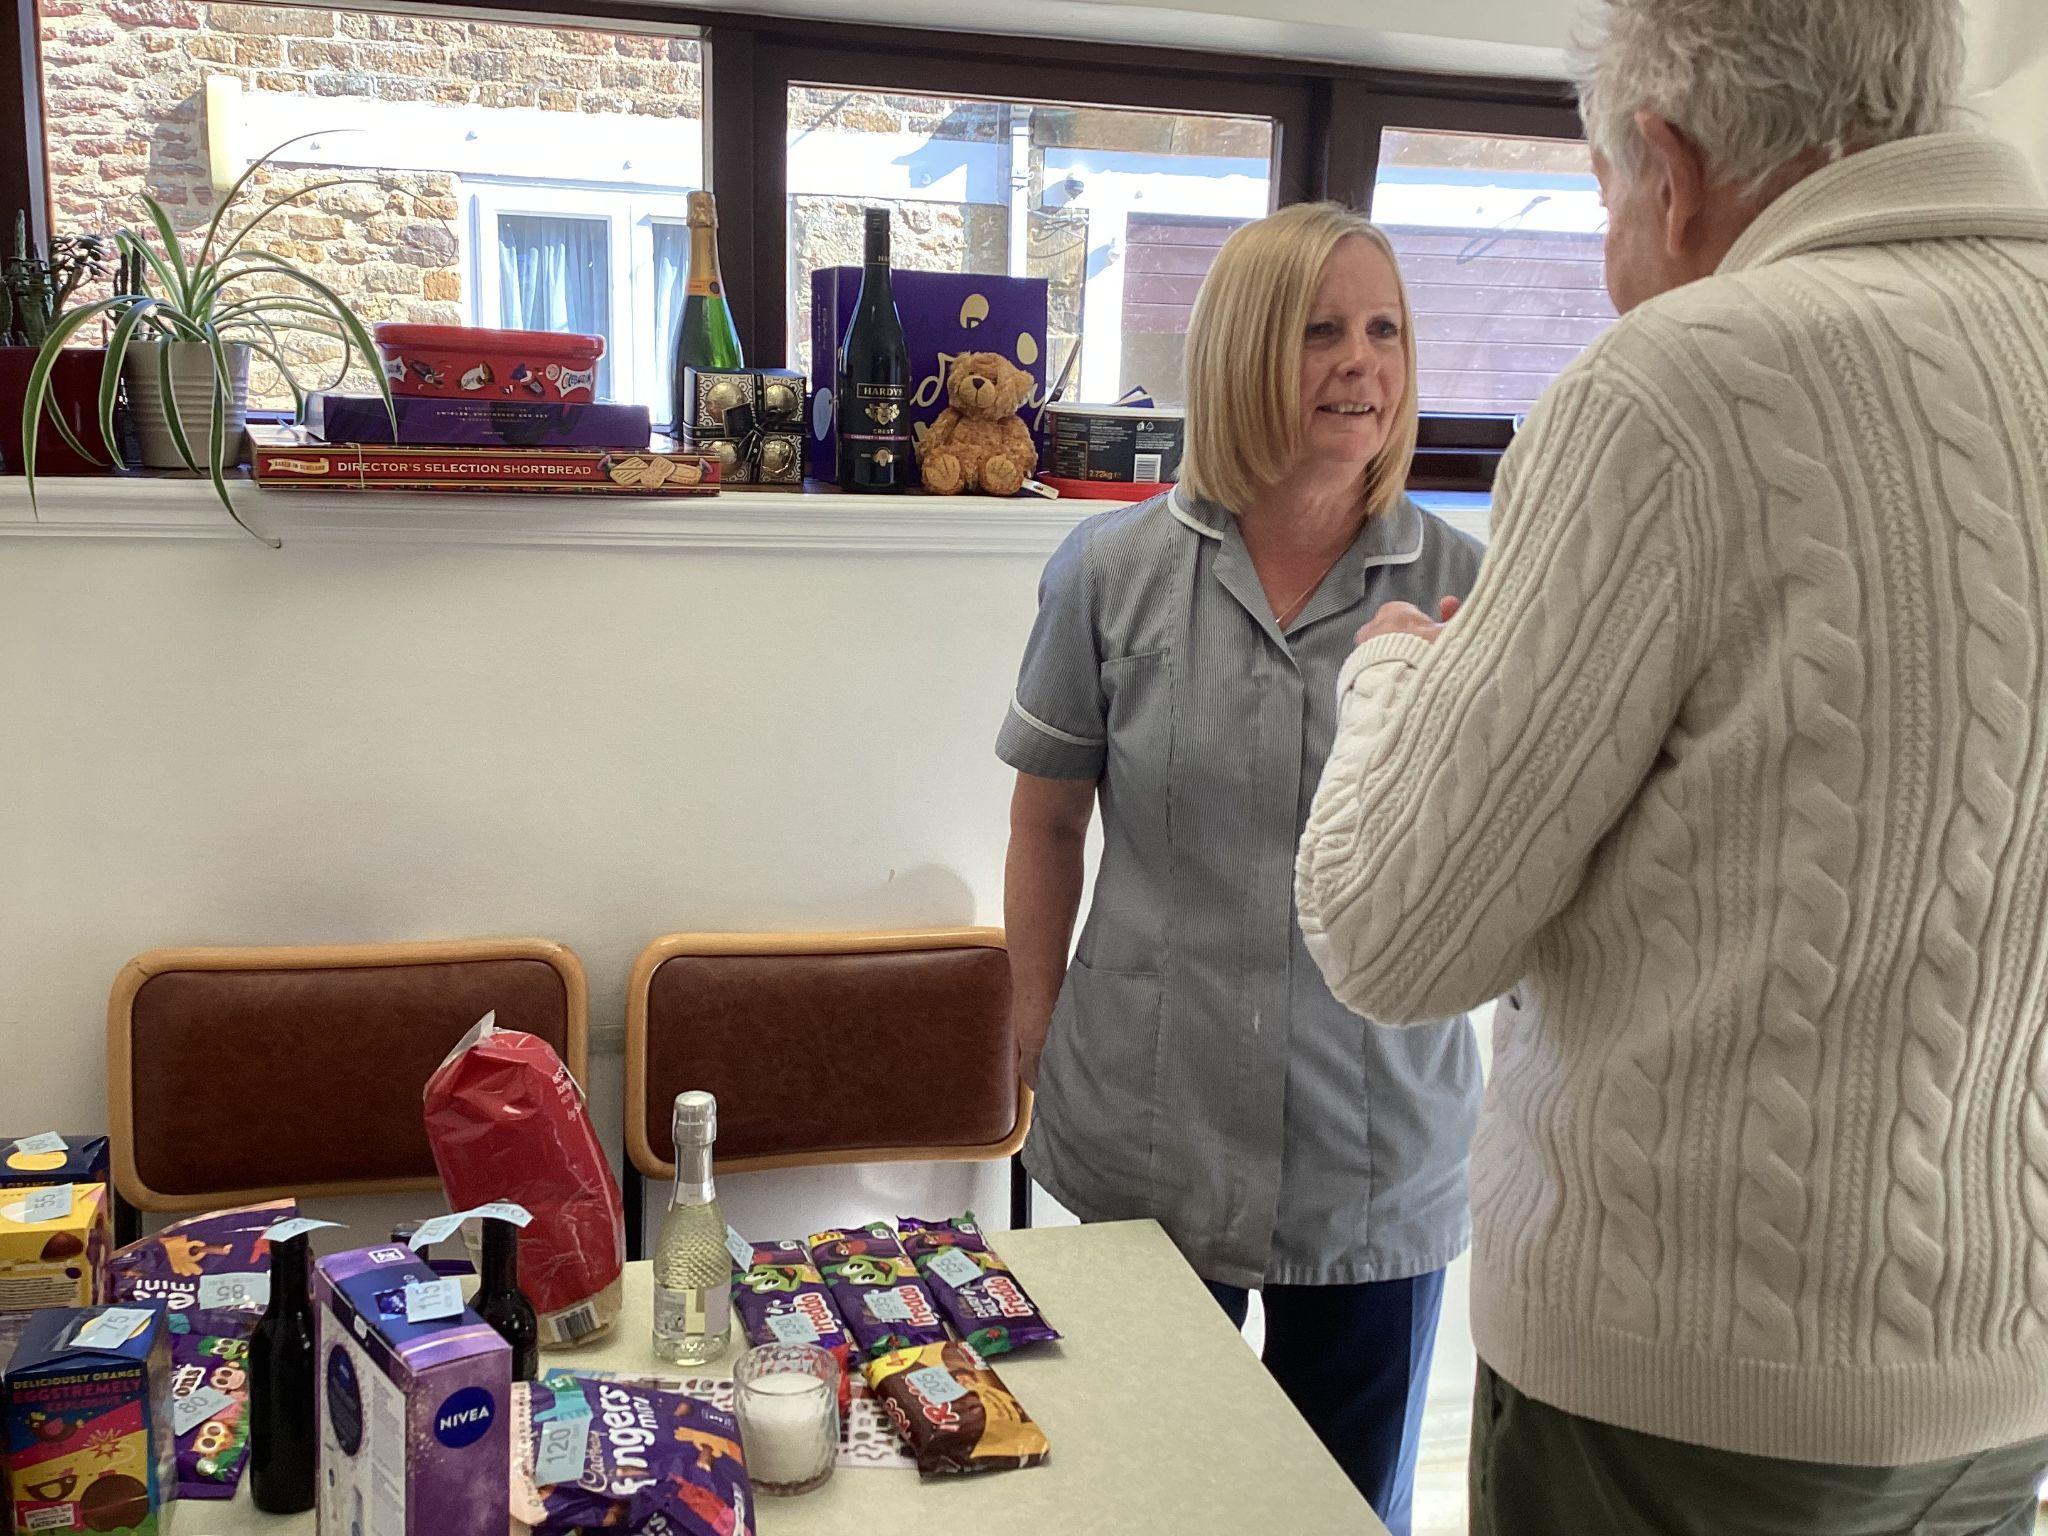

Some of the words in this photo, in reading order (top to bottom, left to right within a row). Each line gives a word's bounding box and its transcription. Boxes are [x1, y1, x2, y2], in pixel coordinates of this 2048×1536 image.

[337, 462, 421, 472] DIRECTOR'S
[424, 463, 500, 473] SELECTION
[503, 464, 592, 475] SHORTBREAD
[34, 1194, 56, 1209] 55
[135, 1279, 195, 1292] mini
[216, 1284, 246, 1301] 85
[985, 1276, 1032, 1317] Freddo
[897, 1286, 939, 1325] Freddo
[97, 1315, 129, 1331] 75
[13, 1374, 89, 1390] DELICIOUSLY
[93, 1369, 142, 1381] ORANGE
[916, 1372, 948, 1396] 205
[13, 1379, 141, 1404] EGGSTREMELY
[178, 1396, 209, 1414] 80
[633, 1395, 659, 1431] mini
[439, 1405, 490, 1431] NIVEA
[546, 1426, 572, 1466] 120
